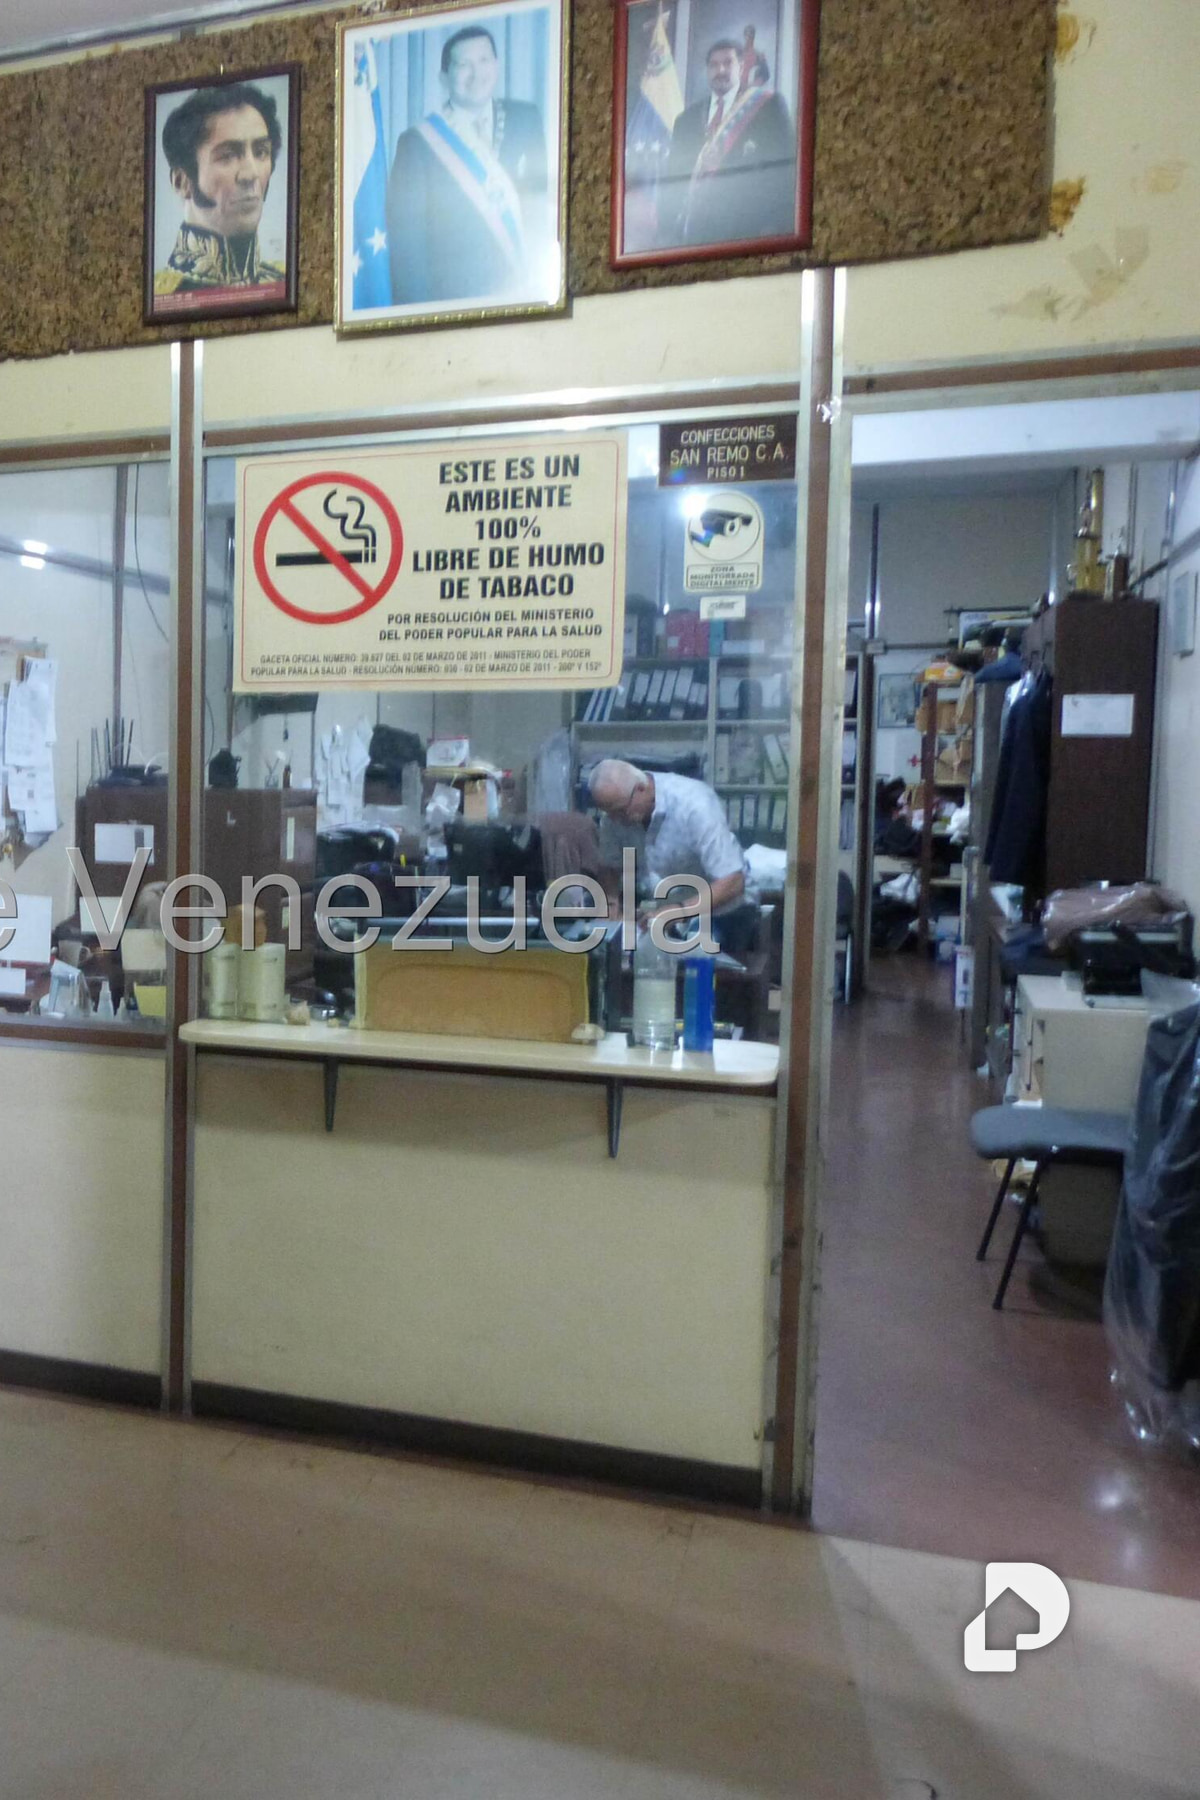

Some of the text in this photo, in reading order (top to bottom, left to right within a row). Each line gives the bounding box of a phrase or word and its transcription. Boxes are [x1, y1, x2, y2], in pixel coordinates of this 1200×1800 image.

[680, 425, 775, 444] CONFECCIONES
[670, 448, 700, 465] SAN
[707, 445, 750, 463] REMO
[440, 454, 580, 484] ESTE ES UN
[707, 466, 745, 478] PISO 1
[445, 484, 572, 513] AMBIENTE
[475, 515, 541, 540] 100%
[412, 542, 605, 572] LIBRE DE HUMO
[440, 573, 574, 600] DE TABACO
[387, 608, 594, 624] POR RESOLUCIÓN DEL MINISTERIO
[379, 624, 602, 641] DEL PODER POPULAR PARA LA SALUD
[260, 654, 290, 664] GACETA
[292, 654, 321, 664] OFICIAL
[386, 652, 400, 662] DEL
[413, 652, 424, 662] DE
[426, 651, 455, 661] MARZO
[456, 651, 467, 661] DE
[470, 651, 487, 660] 2011
[494, 650, 540, 660] MINISTERIO
[543, 650, 559, 659] DEL
[561, 649, 590, 658] PODER
[250, 666, 286, 676] POPULAR
[288, 666, 308, 676] PARA
[310, 666, 320, 675] LA
[321, 666, 346, 675] SALUD
[475, 663, 486, 672] DE
[488, 662, 518, 672] MARZO
[520, 662, 530, 672] DE
[533, 662, 550, 672] 2011
